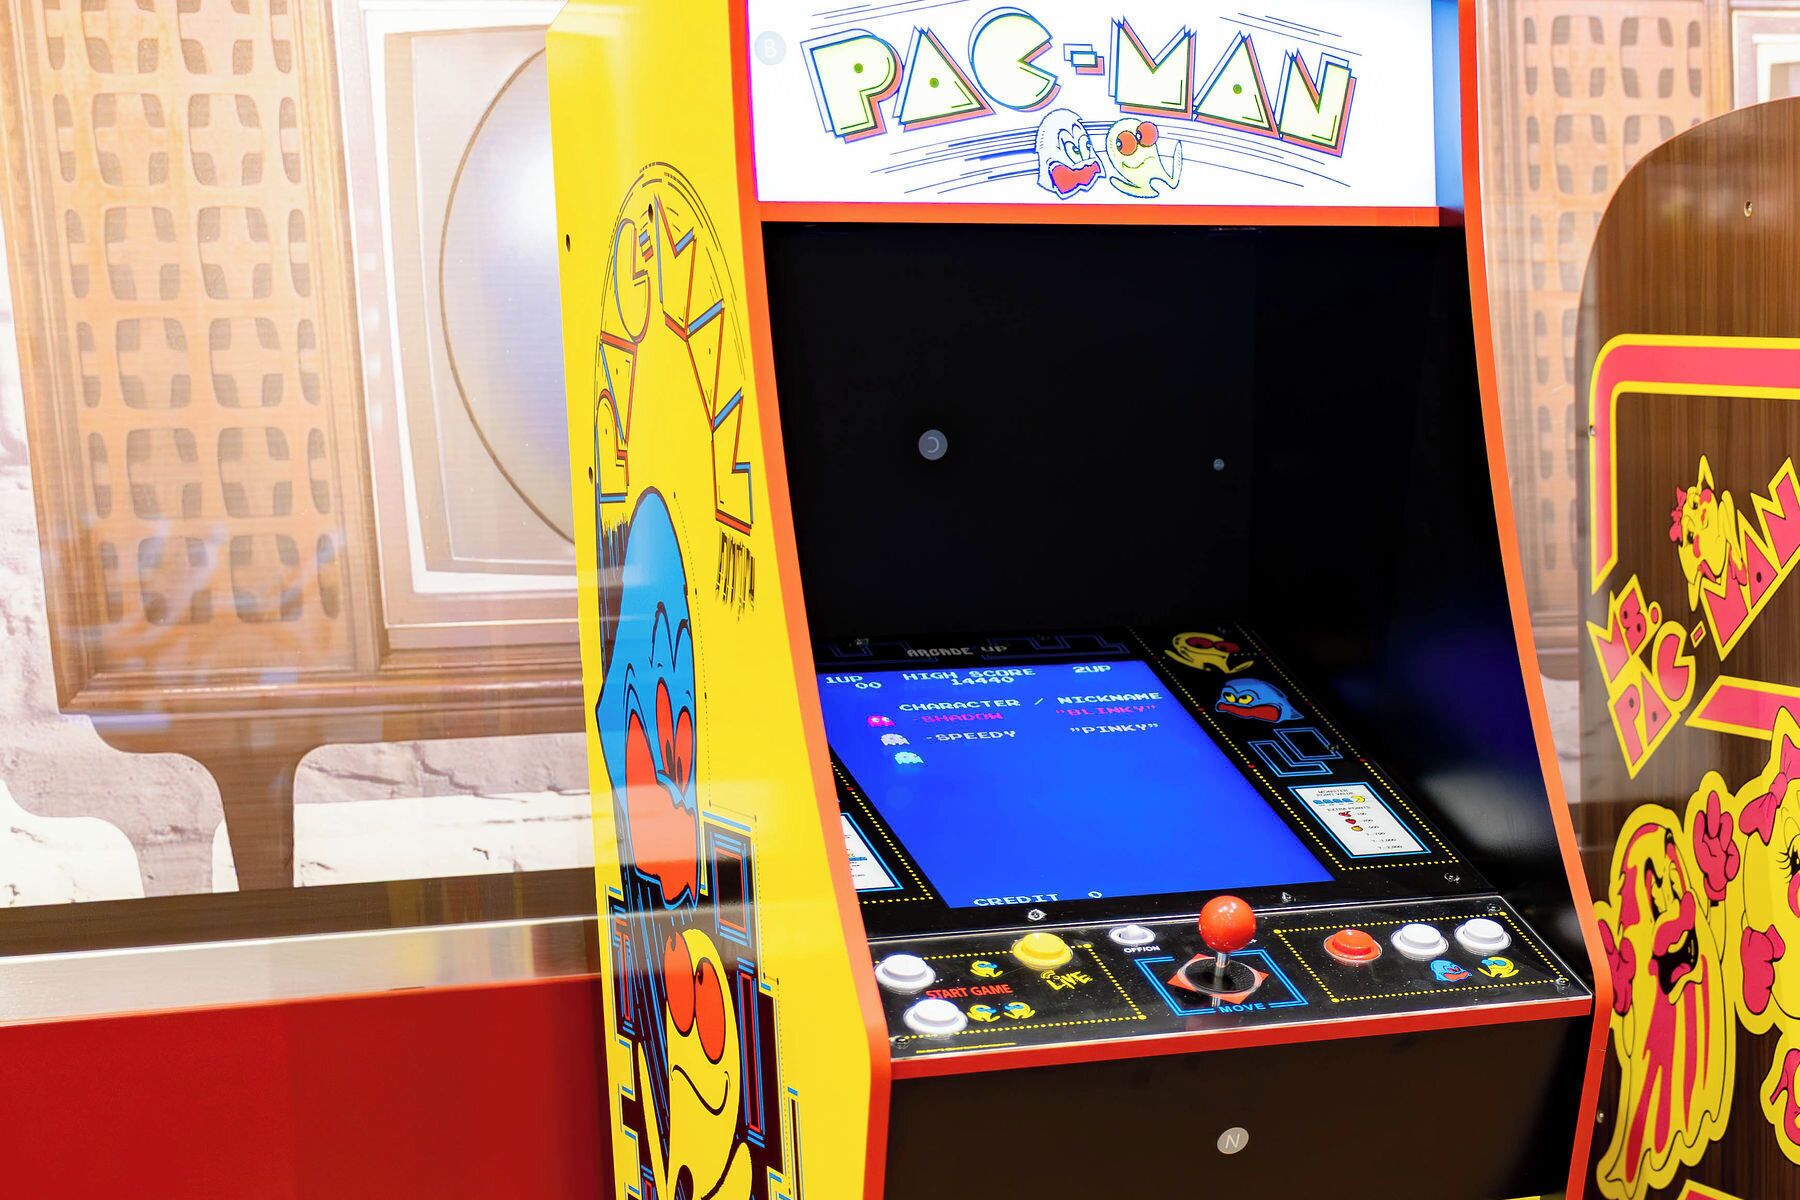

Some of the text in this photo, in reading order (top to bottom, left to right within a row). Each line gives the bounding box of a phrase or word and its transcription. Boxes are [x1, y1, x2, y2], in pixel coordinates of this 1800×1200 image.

[800, 7, 1357, 157] PAC-MAN
[825, 664, 1111, 684] 1UP HIGH SCORE 2UP
[951, 676, 1014, 686] 14440
[899, 699, 1021, 711] CHARACTER
[1057, 692, 1164, 704] NICKNAME
[973, 893, 1059, 907] CREDIT
[926, 984, 1014, 1000] START GAME
[1218, 1002, 1267, 1014] MOVE
